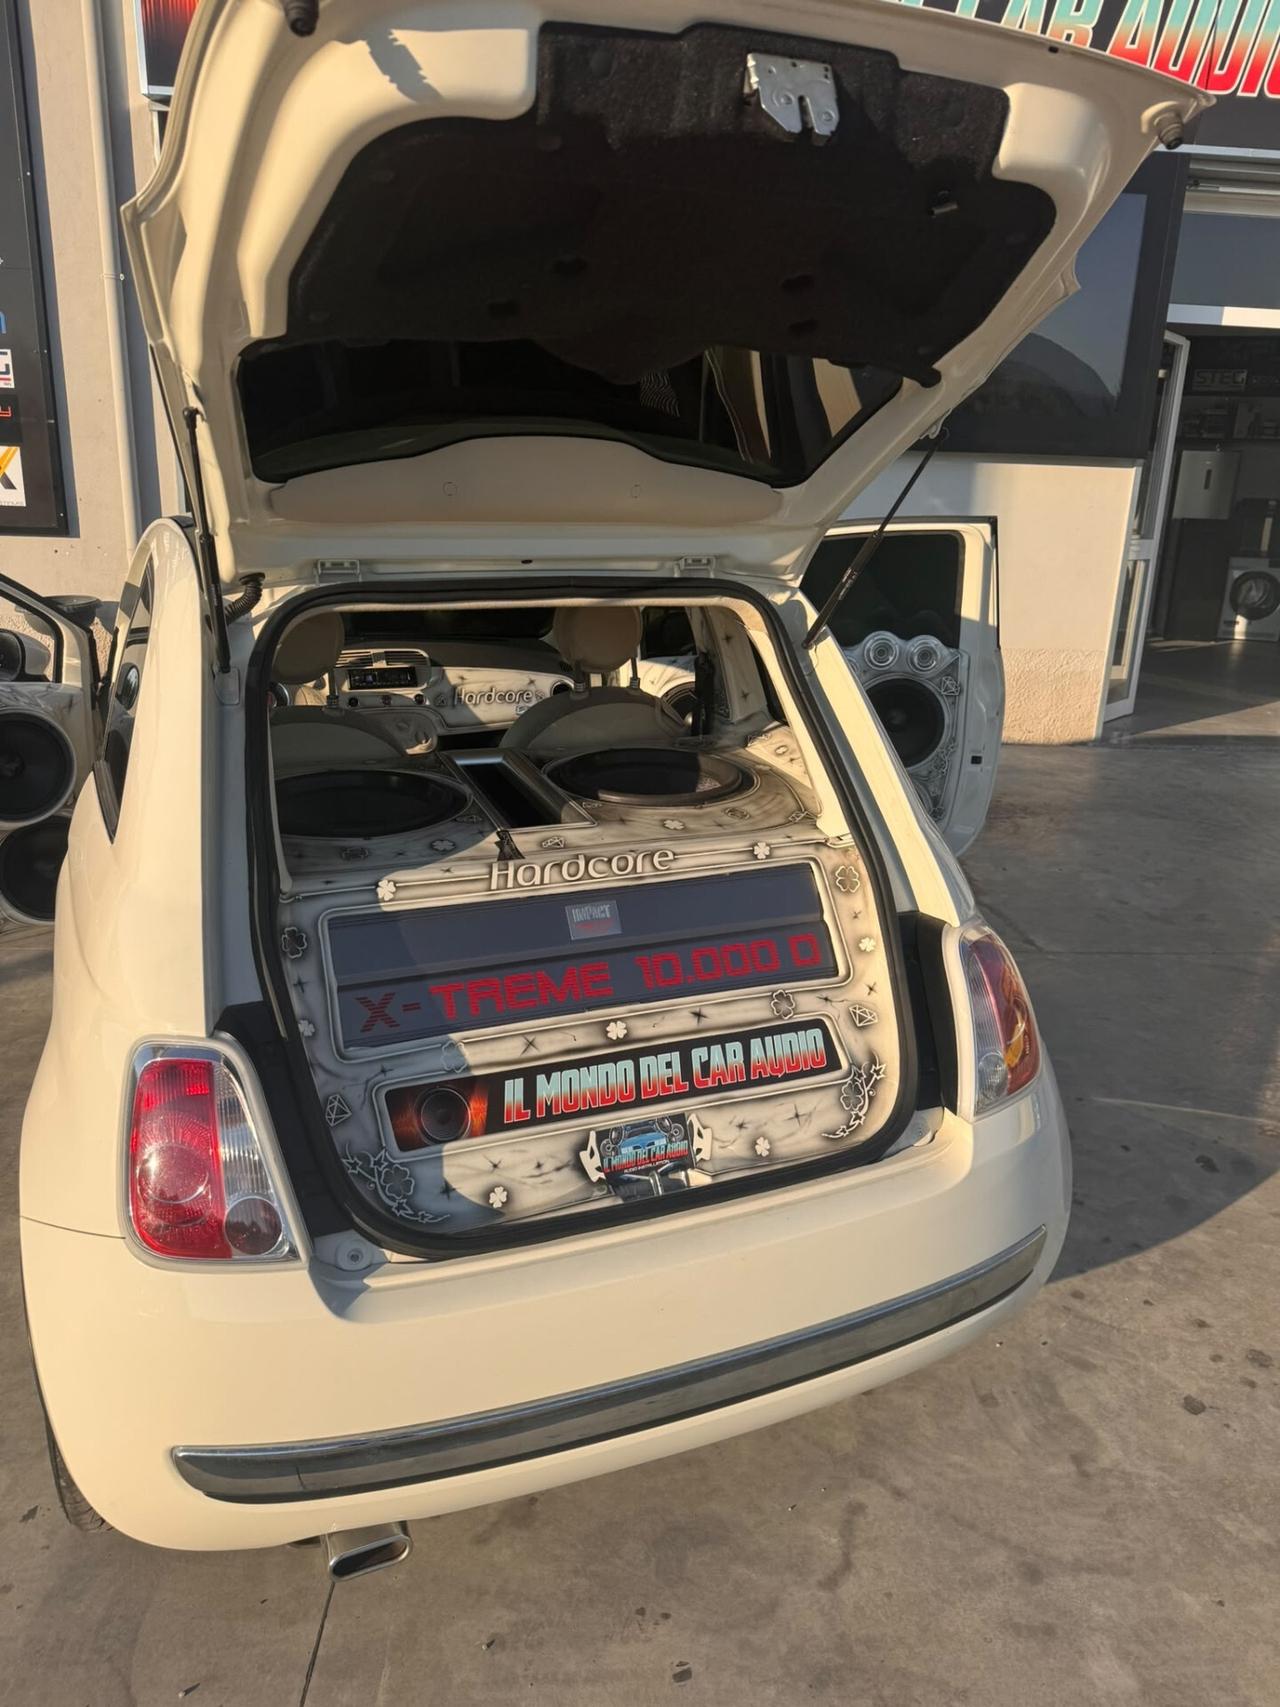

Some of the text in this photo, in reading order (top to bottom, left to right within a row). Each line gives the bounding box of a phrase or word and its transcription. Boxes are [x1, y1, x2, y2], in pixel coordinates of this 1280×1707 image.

[454, 687, 533, 706] Hardcore
[490, 849, 675, 891] Hardcore
[572, 904, 611, 923] IMPACT
[634, 938, 782, 989] 10.000
[503, 1027, 827, 1124] IL MONDO DEL CAR AUDIO
[610, 1150, 637, 1171] MONDO
[636, 1148, 650, 1166] DEL
[650, 1145, 666, 1162] CAR
[666, 1140, 689, 1159] AUDIO
